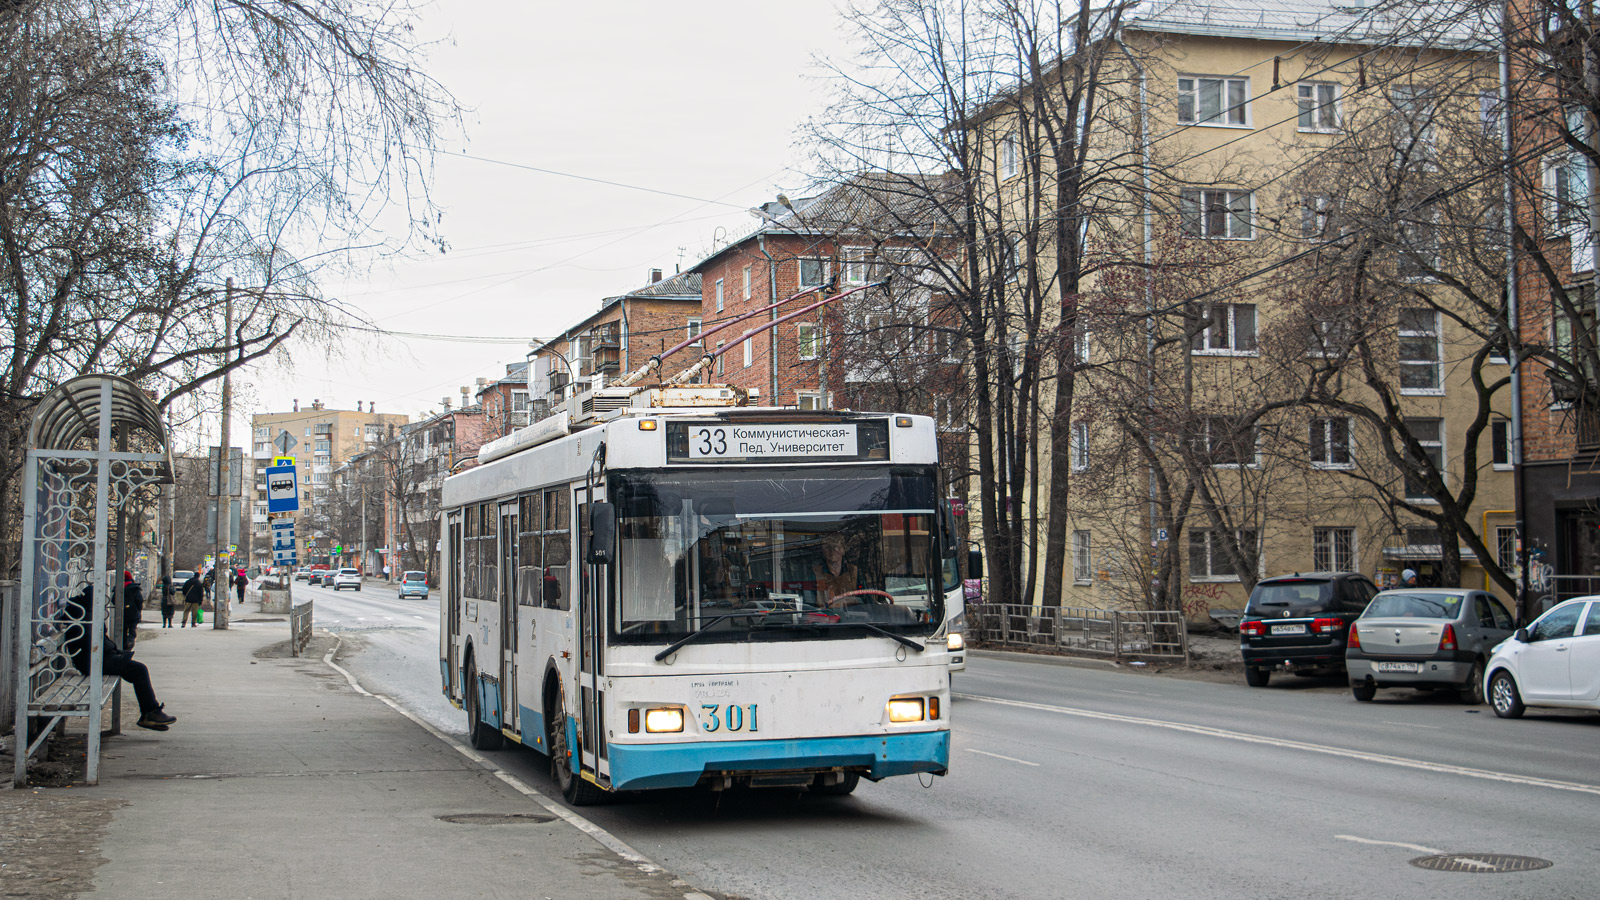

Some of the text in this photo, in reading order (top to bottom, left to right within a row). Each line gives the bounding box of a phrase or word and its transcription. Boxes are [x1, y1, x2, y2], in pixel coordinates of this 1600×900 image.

[699, 429, 727, 455] 33
[733, 428, 850, 440] Коммунистическая-
[740, 441, 845, 454] Пед. Университет
[702, 704, 758, 732] 301
